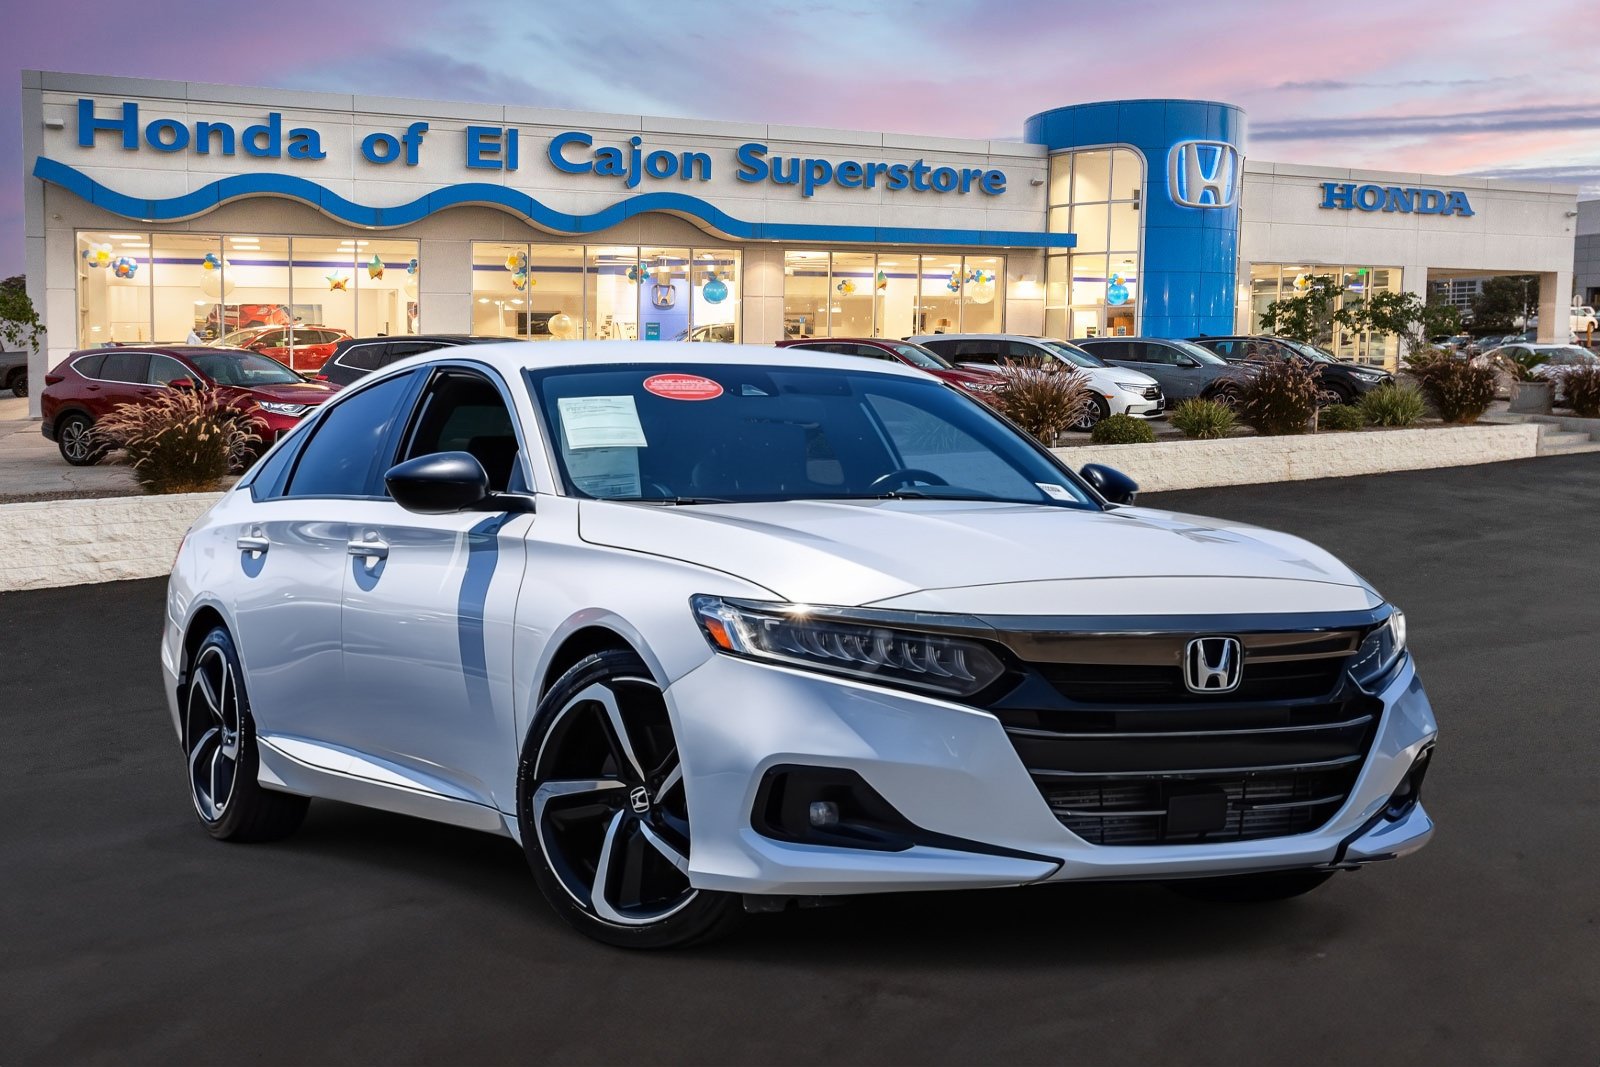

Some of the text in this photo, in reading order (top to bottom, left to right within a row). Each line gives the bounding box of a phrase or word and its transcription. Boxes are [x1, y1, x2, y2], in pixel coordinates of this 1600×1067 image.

[77, 98, 1007, 198] Honda of El Cajon Superstore
[1319, 181, 1475, 217] HONDA
